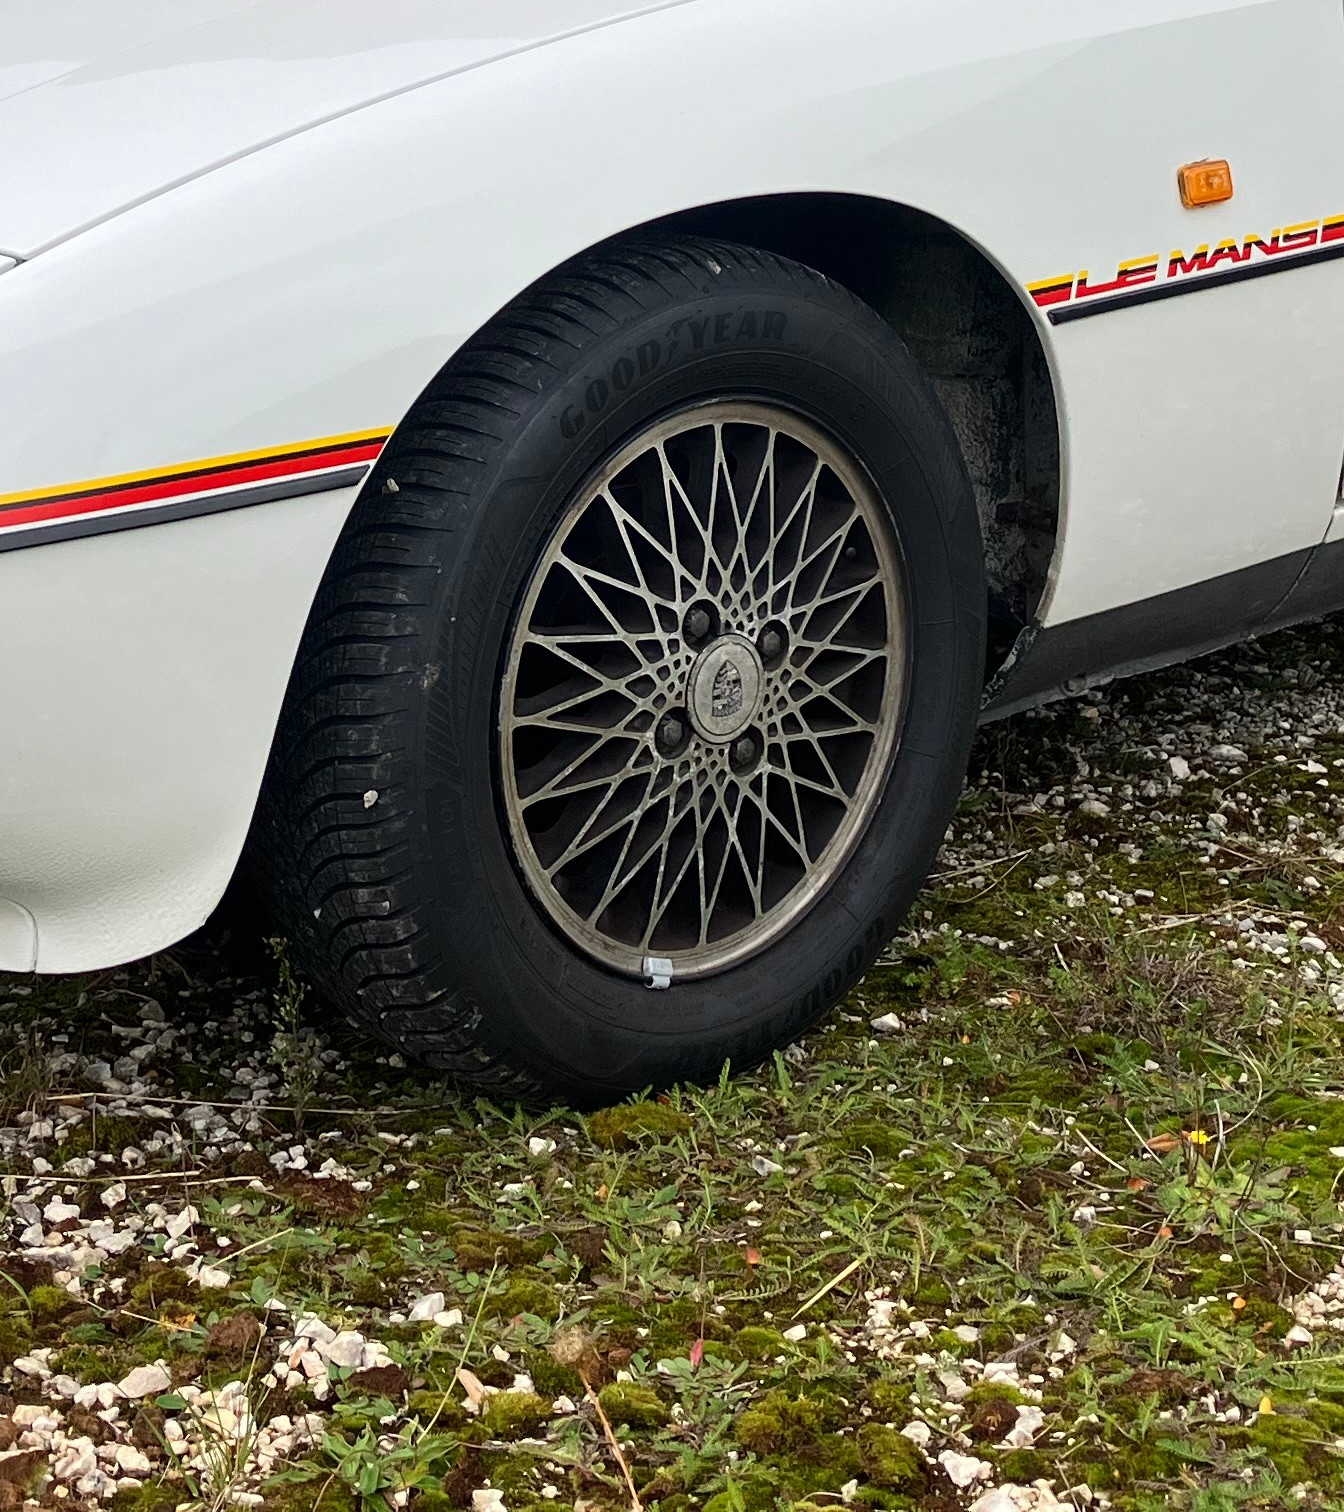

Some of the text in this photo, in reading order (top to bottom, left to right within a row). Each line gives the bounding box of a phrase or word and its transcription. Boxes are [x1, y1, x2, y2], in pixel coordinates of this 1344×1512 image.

[1076, 220, 1319, 298] LE MANS
[560, 309, 788, 438] GOODYEAR
